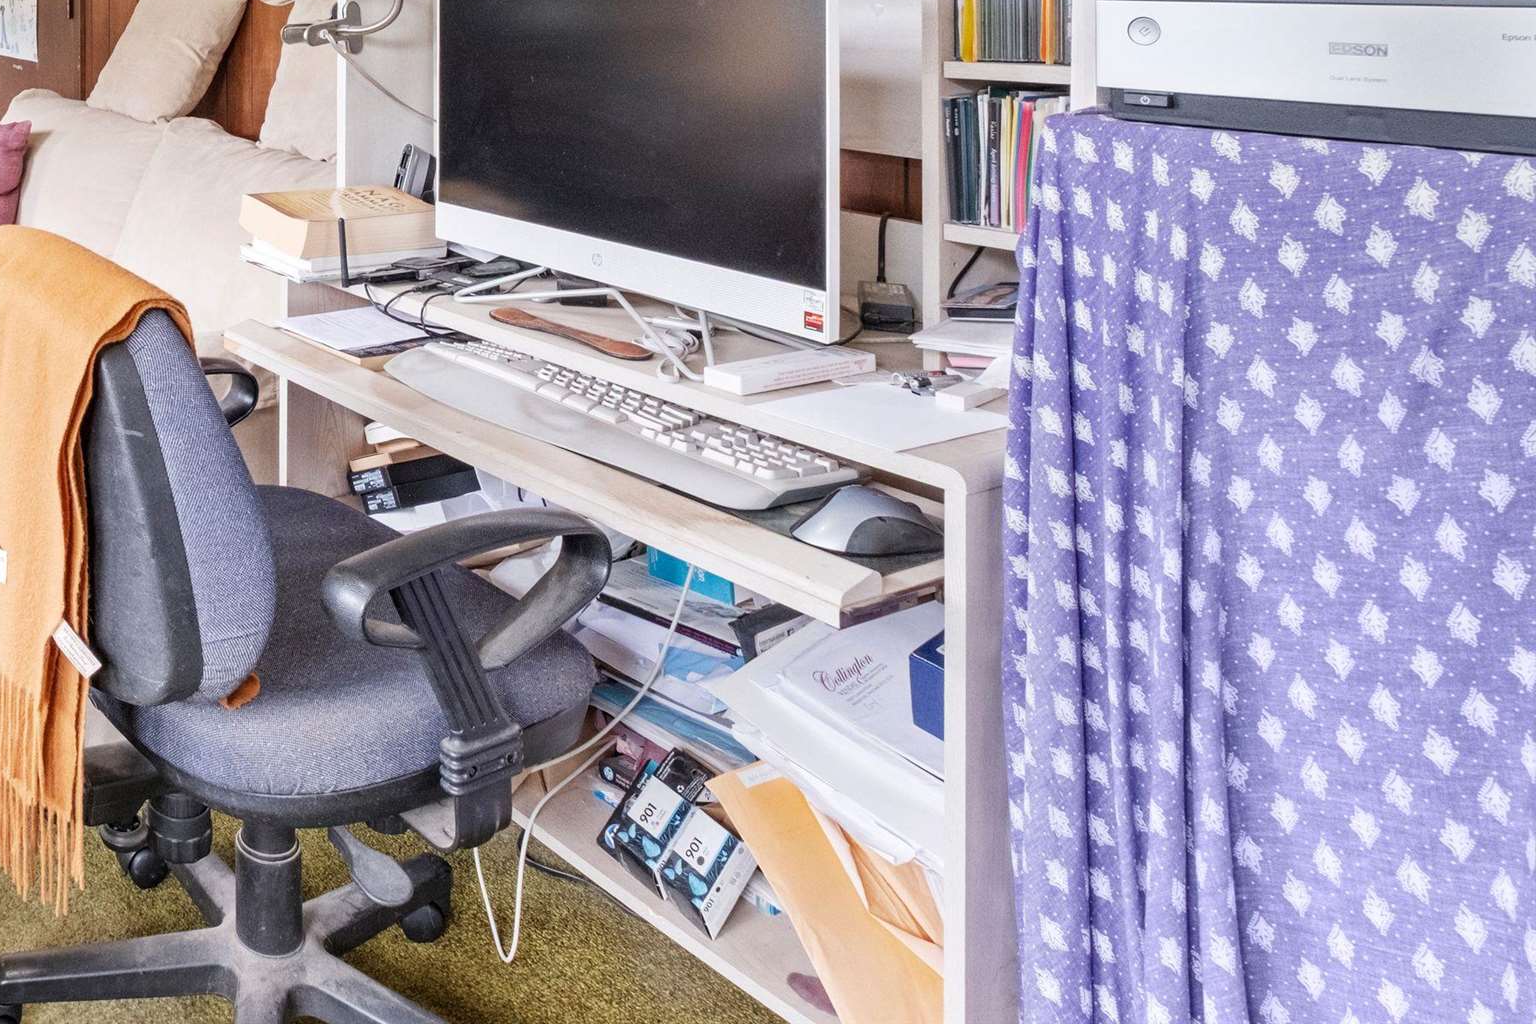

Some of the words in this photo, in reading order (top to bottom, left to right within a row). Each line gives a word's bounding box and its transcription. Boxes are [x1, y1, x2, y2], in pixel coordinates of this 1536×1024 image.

[1502, 33, 1531, 42] Epson
[1328, 41, 1389, 57] EPSON
[812, 653, 873, 692] Collington
[639, 802, 657, 824] 901
[685, 836, 703, 859] 901
[703, 897, 715, 913] 901
